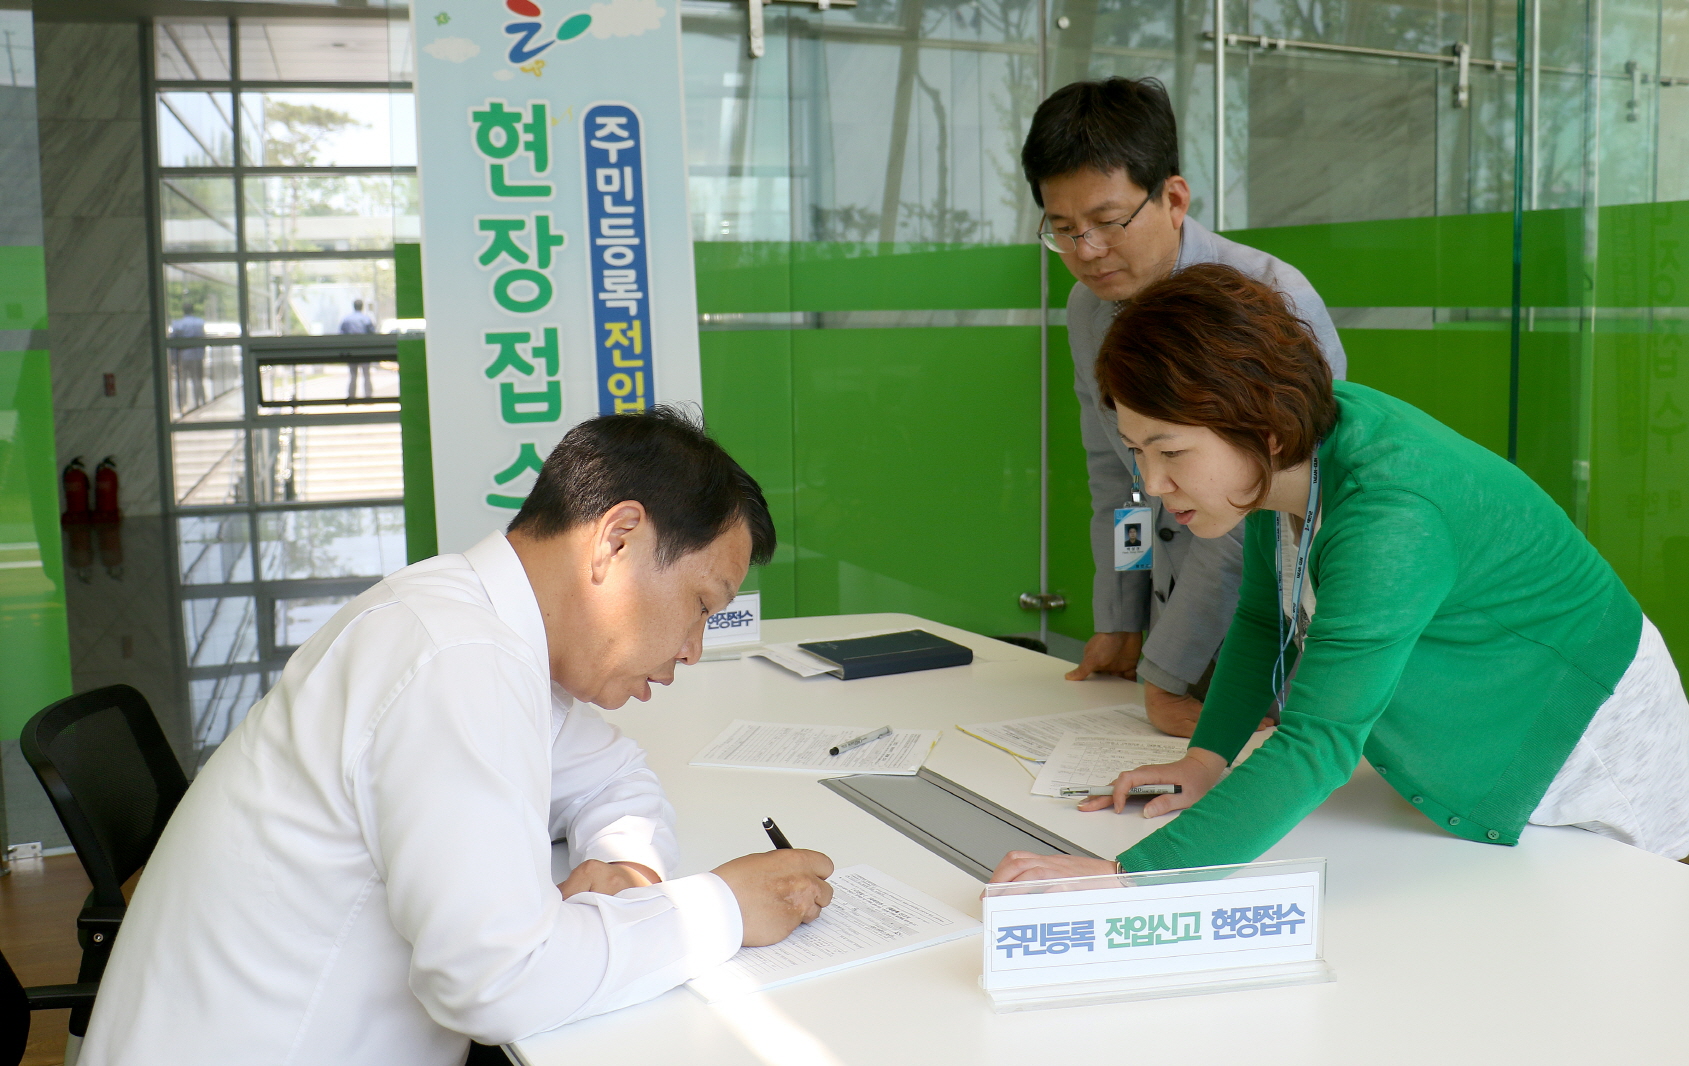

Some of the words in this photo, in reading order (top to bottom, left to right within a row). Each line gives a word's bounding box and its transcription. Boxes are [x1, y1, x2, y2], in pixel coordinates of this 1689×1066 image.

[590, 115, 643, 316] 주민등록
[996, 919, 1096, 959] 주민등록
[1104, 910, 1203, 950] 전입신고
[1211, 902, 1306, 941] 현장접수
